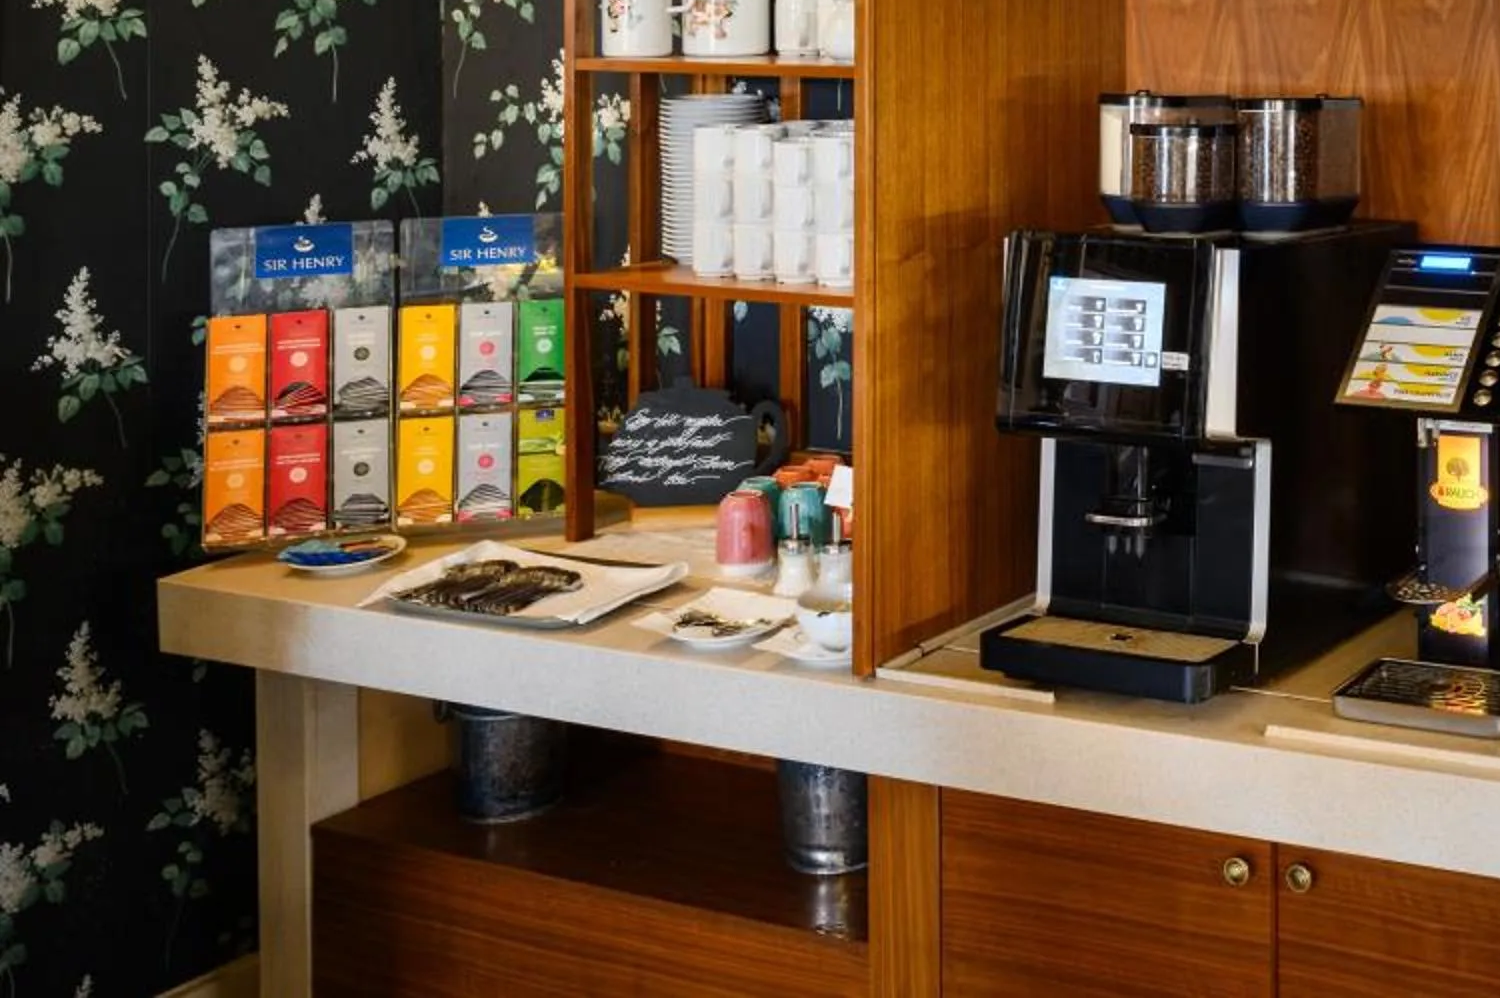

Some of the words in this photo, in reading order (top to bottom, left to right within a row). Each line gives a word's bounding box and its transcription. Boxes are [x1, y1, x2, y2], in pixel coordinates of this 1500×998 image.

[450, 249, 472, 261] SIR
[477, 245, 526, 259] HENRY
[263, 258, 287, 272] SIR
[292, 254, 345, 270] HENRY
